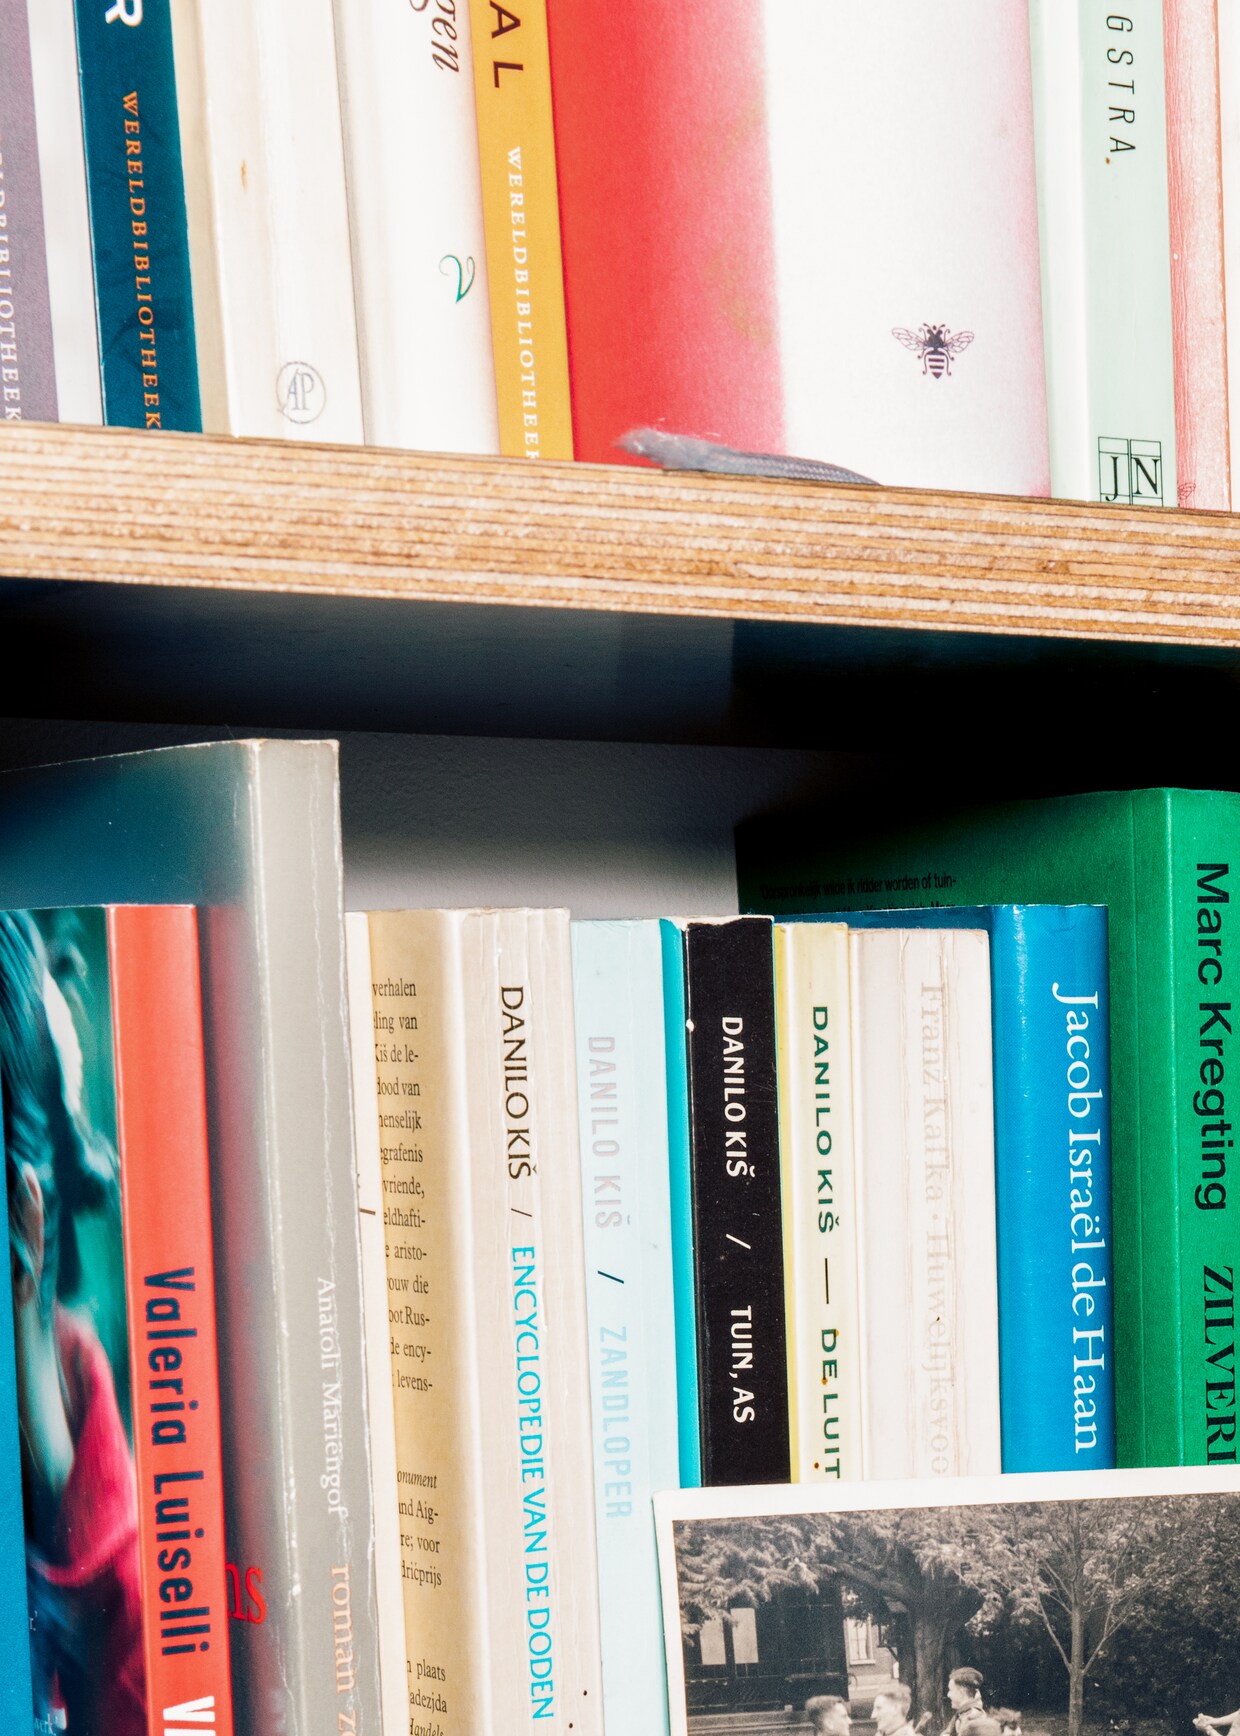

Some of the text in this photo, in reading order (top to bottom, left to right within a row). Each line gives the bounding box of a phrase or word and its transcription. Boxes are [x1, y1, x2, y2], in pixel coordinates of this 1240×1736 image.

[123, 90, 162, 430] WERELDBIBLIOTHEEK
[372, 979, 417, 998] verhalen
[1192, 862, 1233, 1211] Marc Kregting
[588, 1035, 620, 1157] DANILO
[812, 1006, 832, 1156] DANILO
[722, 1016, 755, 1424] DANILO KIŠ TUIN, AS
[818, 1168, 840, 1235] KIŠ
[1052, 982, 1106, 1455] Jacob Israël de Haan
[143, 1267, 199, 1447] Valeria
[316, 1276, 340, 1371] Anatoli
[501, 985, 555, 1719] DANILO KIŠ ENCYCLOPEDIE VAN DE DODEN
[820, 1328, 839, 1380] DE
[320, 1383, 349, 1517] Mariengof
[600, 1326, 633, 1518] ZANDLOPER
[151, 1470, 212, 1657] Luiselli
[330, 1562, 356, 1694] roman
